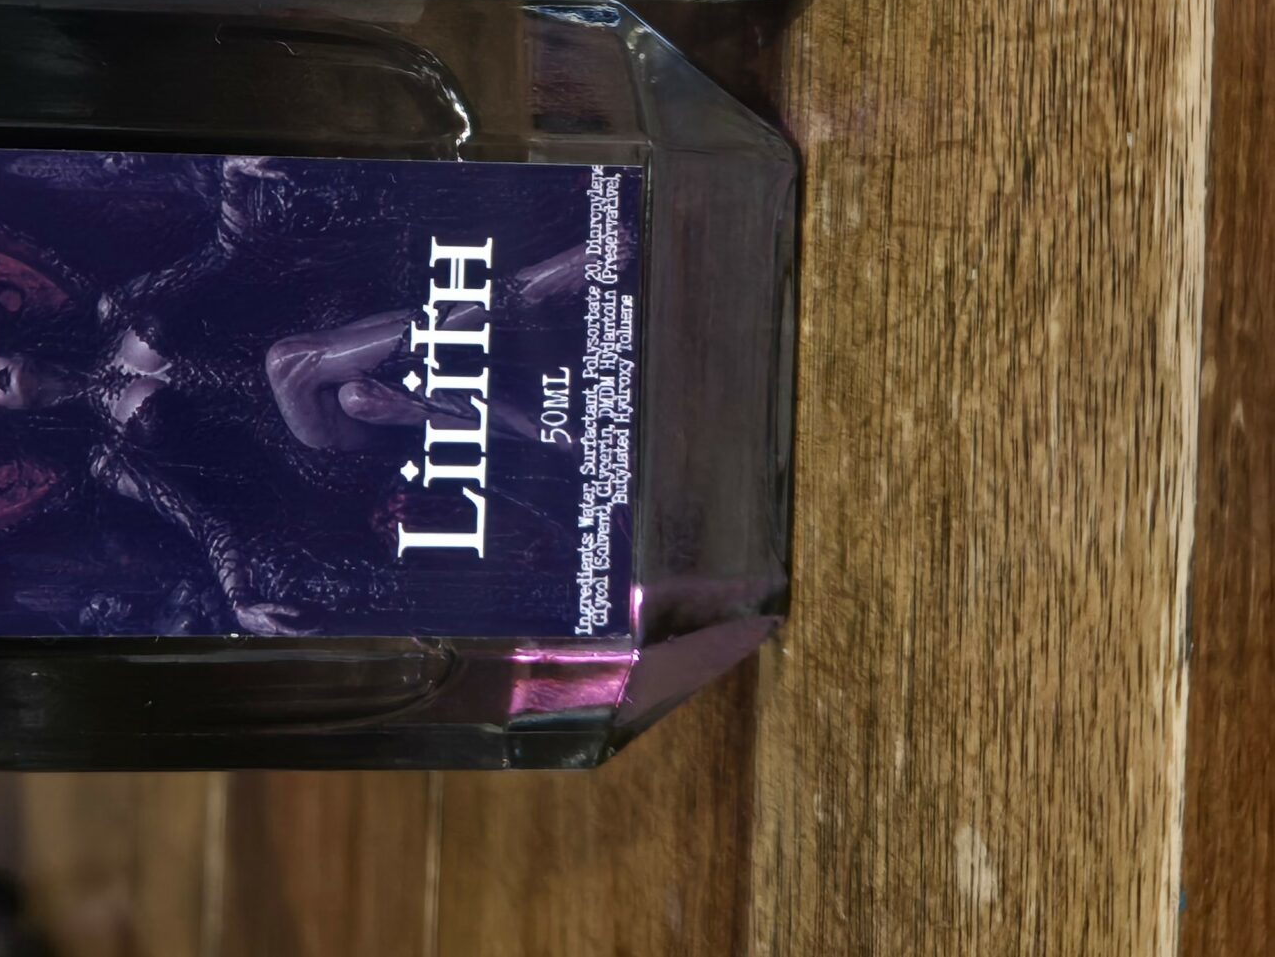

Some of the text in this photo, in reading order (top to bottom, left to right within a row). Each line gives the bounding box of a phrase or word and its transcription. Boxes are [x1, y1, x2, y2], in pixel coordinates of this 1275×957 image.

[616, 295, 633, 352] Toluene
[540, 366, 571, 443] 50ML
[580, 384, 599, 475] Surfactant,
[578, 480, 595, 528] Water,
[575, 532, 596, 635] Ingredients:
[593, 576, 611, 626] Glycol
